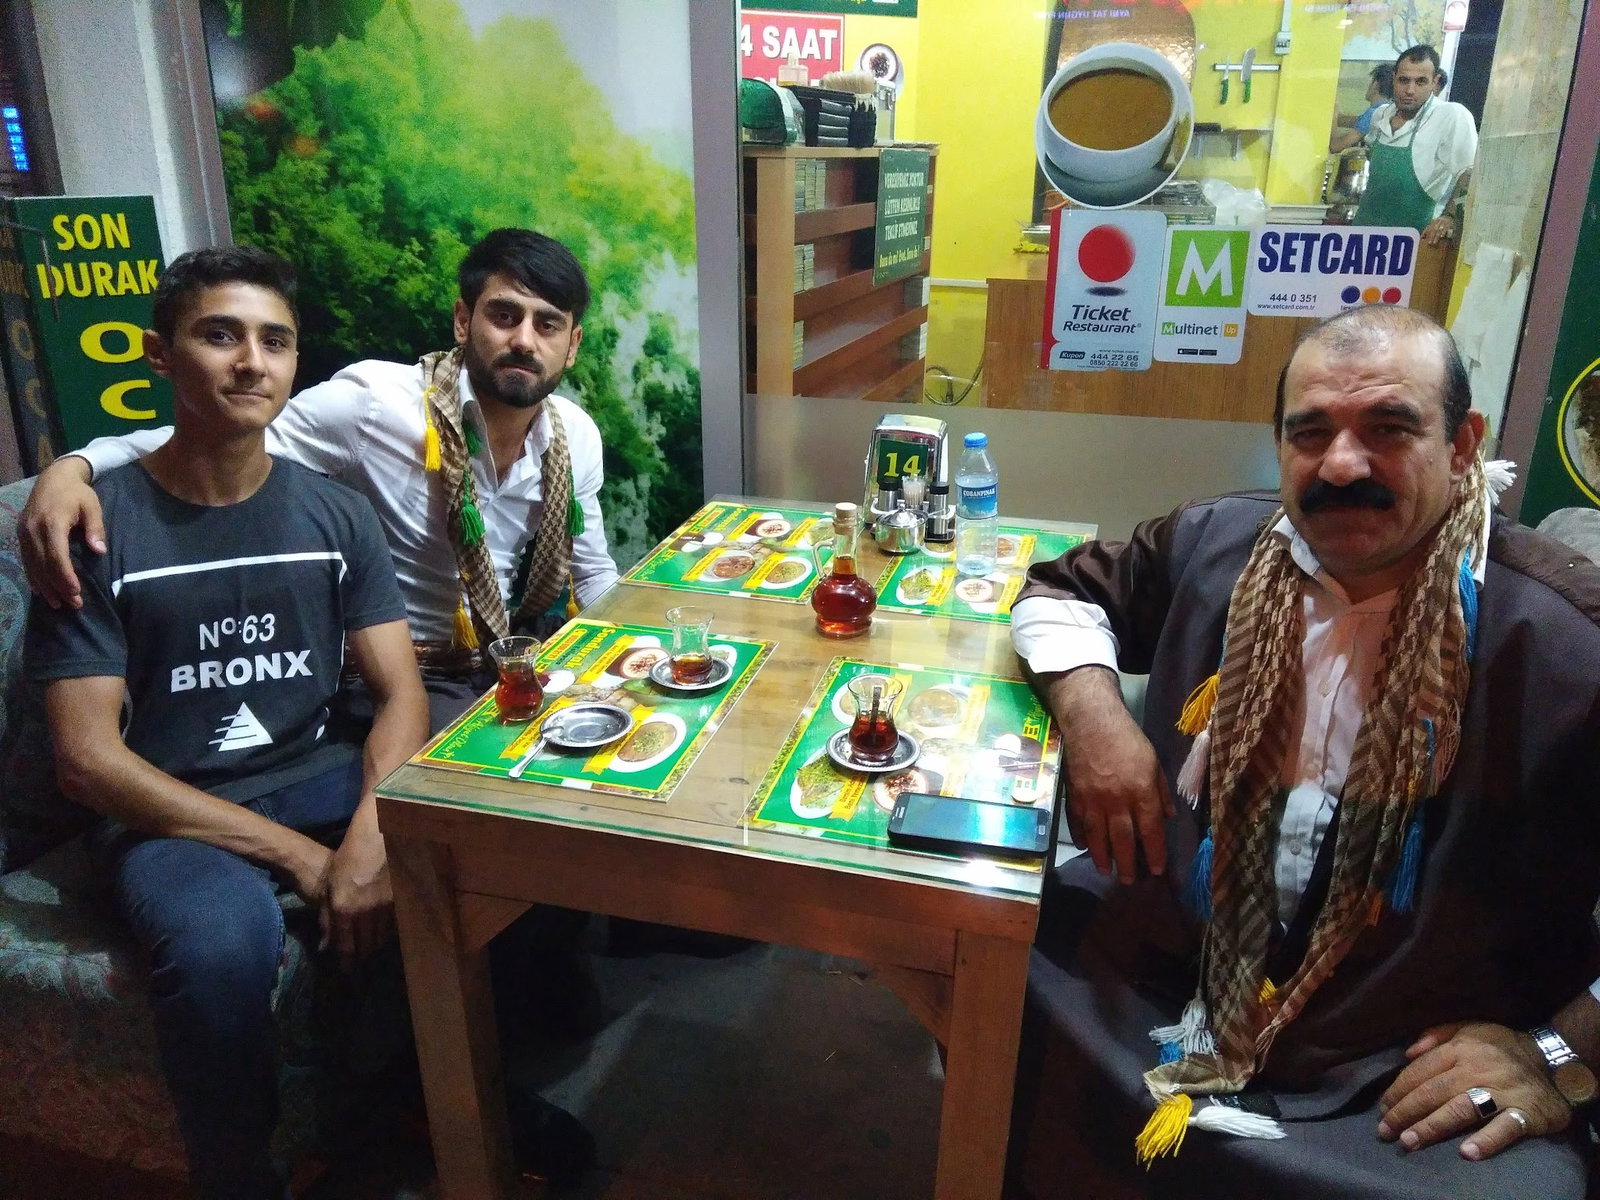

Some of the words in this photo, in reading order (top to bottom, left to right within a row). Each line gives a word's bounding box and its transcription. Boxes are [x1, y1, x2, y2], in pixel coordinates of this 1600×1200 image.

[762, 26, 838, 60] SAAT
[53, 213, 131, 251] SON
[1258, 232, 1415, 276] SETCARD
[36, 259, 159, 299] DURAK
[1270, 293, 1287, 302] 444
[1290, 293, 1297, 302] 0
[1300, 294, 1317, 303] 351
[1072, 304, 1131, 321] Ticket
[1162, 322, 1219, 336] Multinet
[1225, 325, 1237, 335] Up
[1061, 351, 1083, 360] Kupon
[1090, 353, 1108, 361] 444
[1111, 353, 1124, 361] 22
[1126, 354, 1139, 362] 66
[884, 452, 921, 478] 14
[170, 649, 313, 694] BRONX
